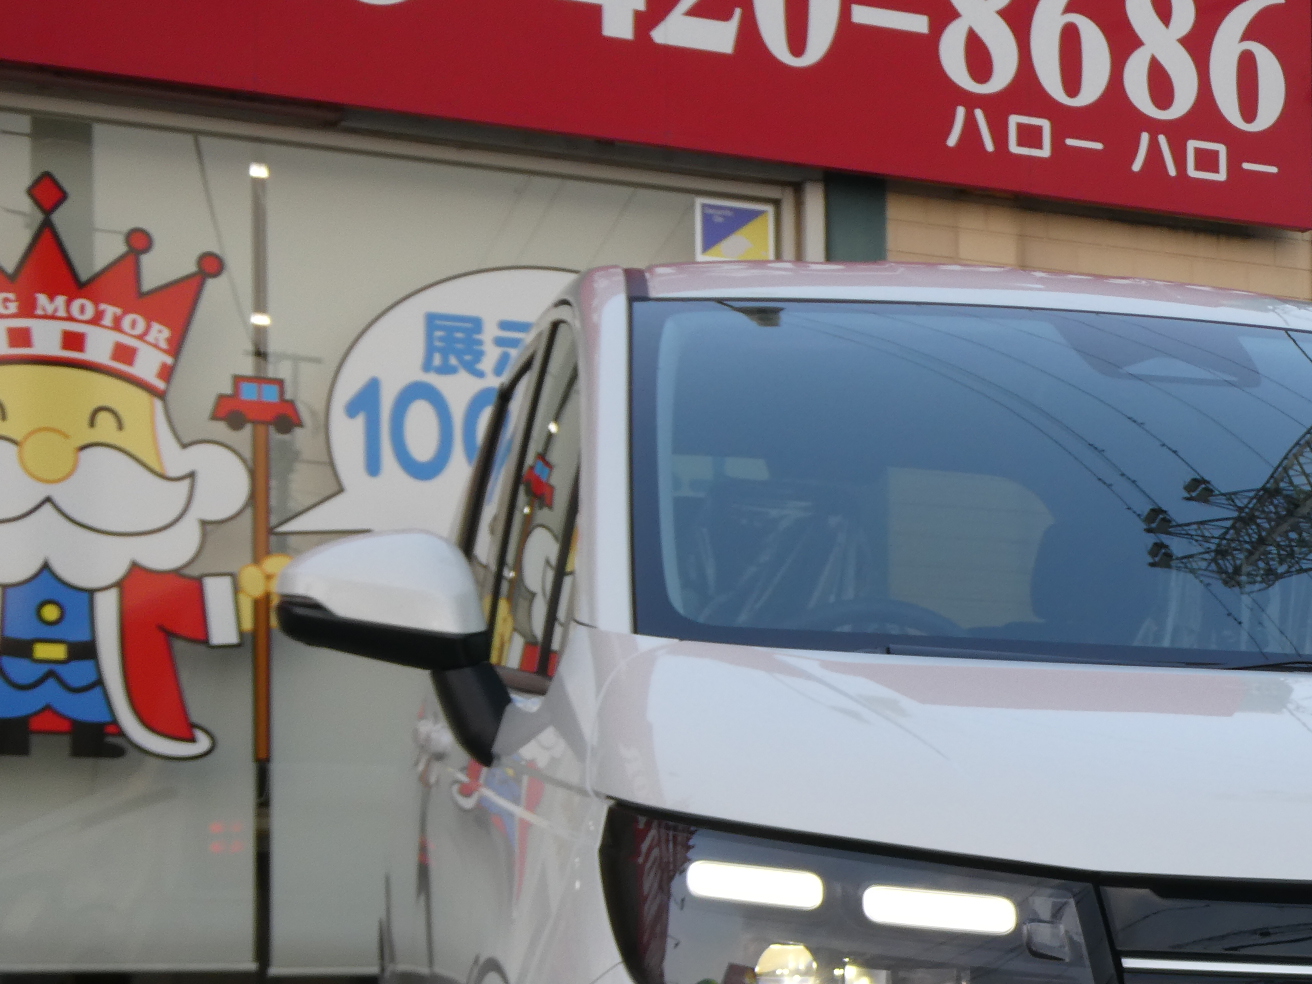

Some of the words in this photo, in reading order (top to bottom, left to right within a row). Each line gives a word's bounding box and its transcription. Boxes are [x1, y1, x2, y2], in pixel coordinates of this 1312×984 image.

[570, 0, 1286, 132] -8686
[946, 105, 1104, 158] ハロー
[1131, 131, 1278, 182] ハロー
[34, 292, 172, 350] MOTOR
